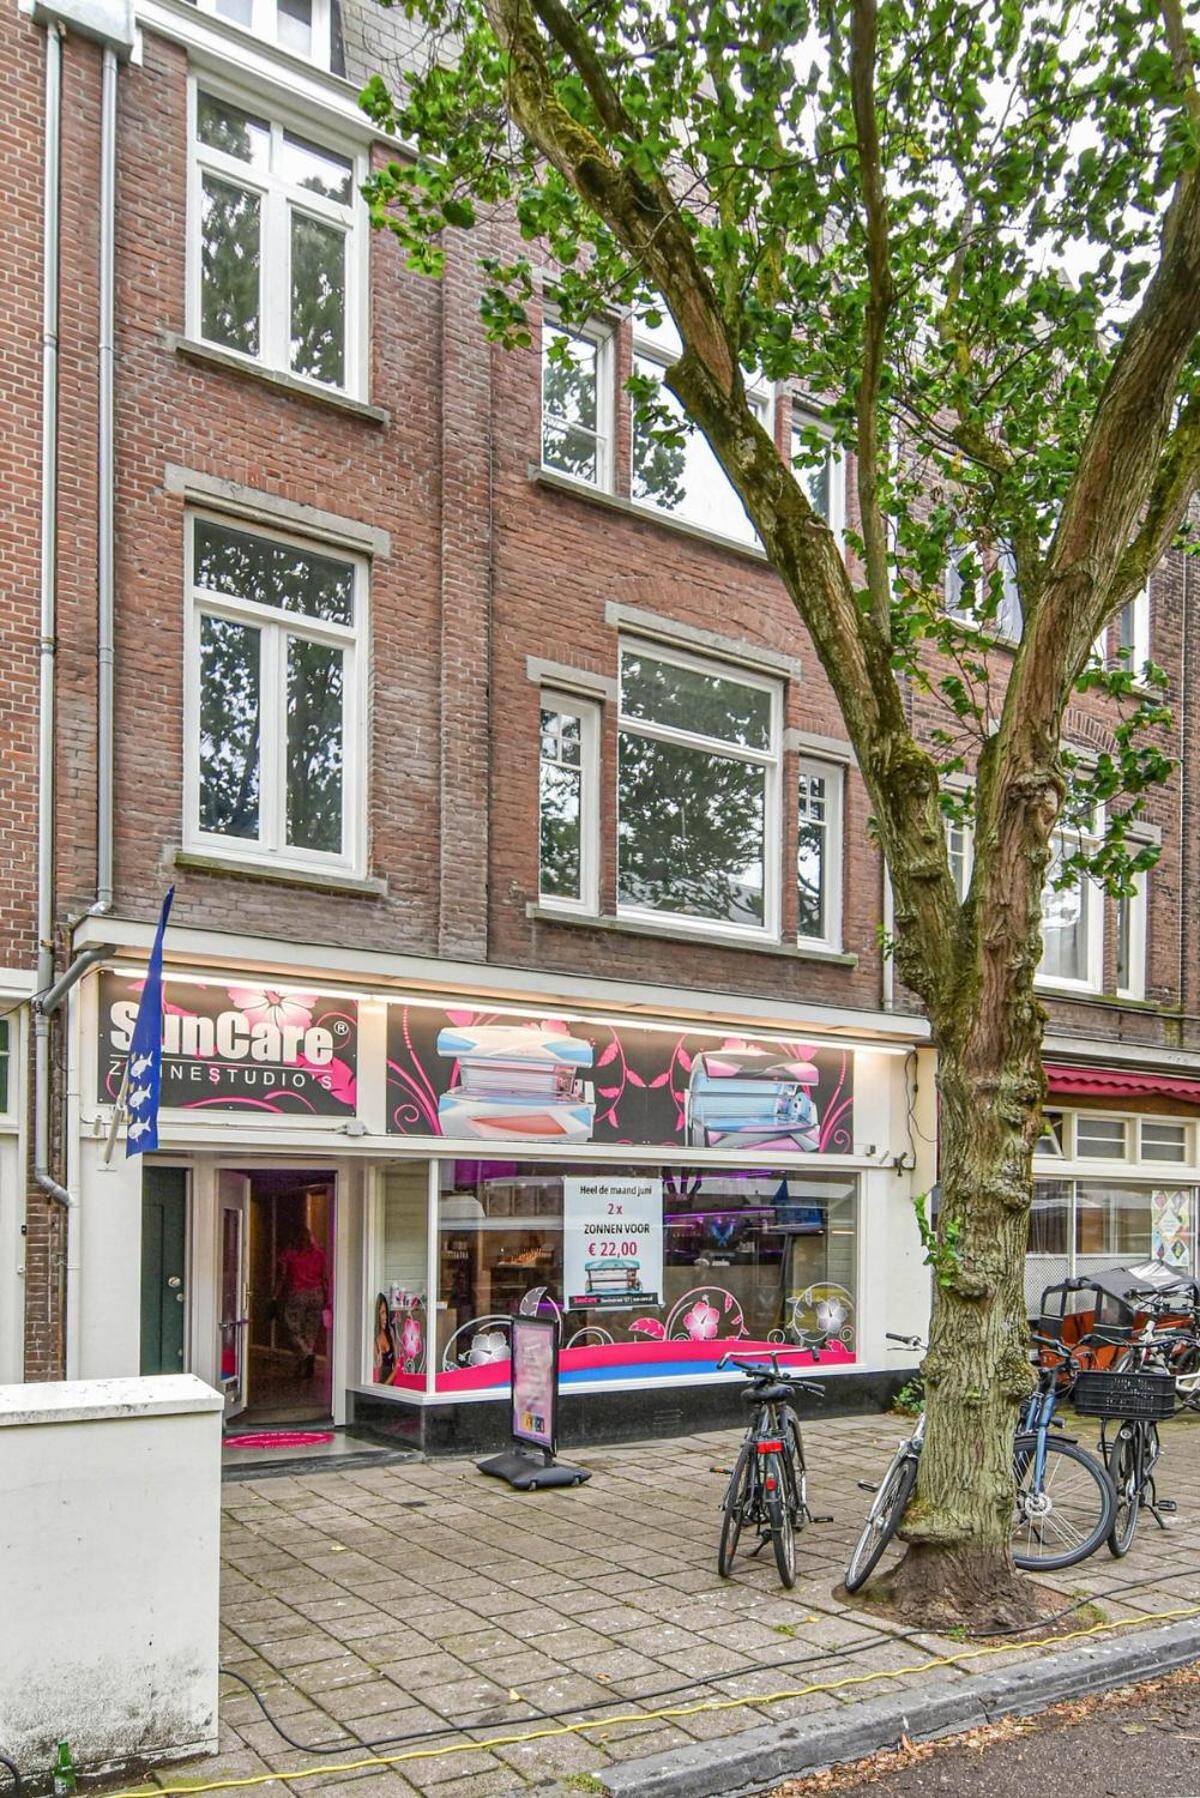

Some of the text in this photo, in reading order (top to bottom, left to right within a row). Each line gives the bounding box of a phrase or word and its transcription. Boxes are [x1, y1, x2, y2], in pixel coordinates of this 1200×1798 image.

[109, 1060, 332, 1089] ZNESTUDIO'S
[580, 1185, 652, 1197] Heel de maand juni
[607, 1203, 623, 1215] 2 x
[584, 1223, 651, 1234] ZONNEN VOOR
[588, 1241, 638, 1258] € 22,00
